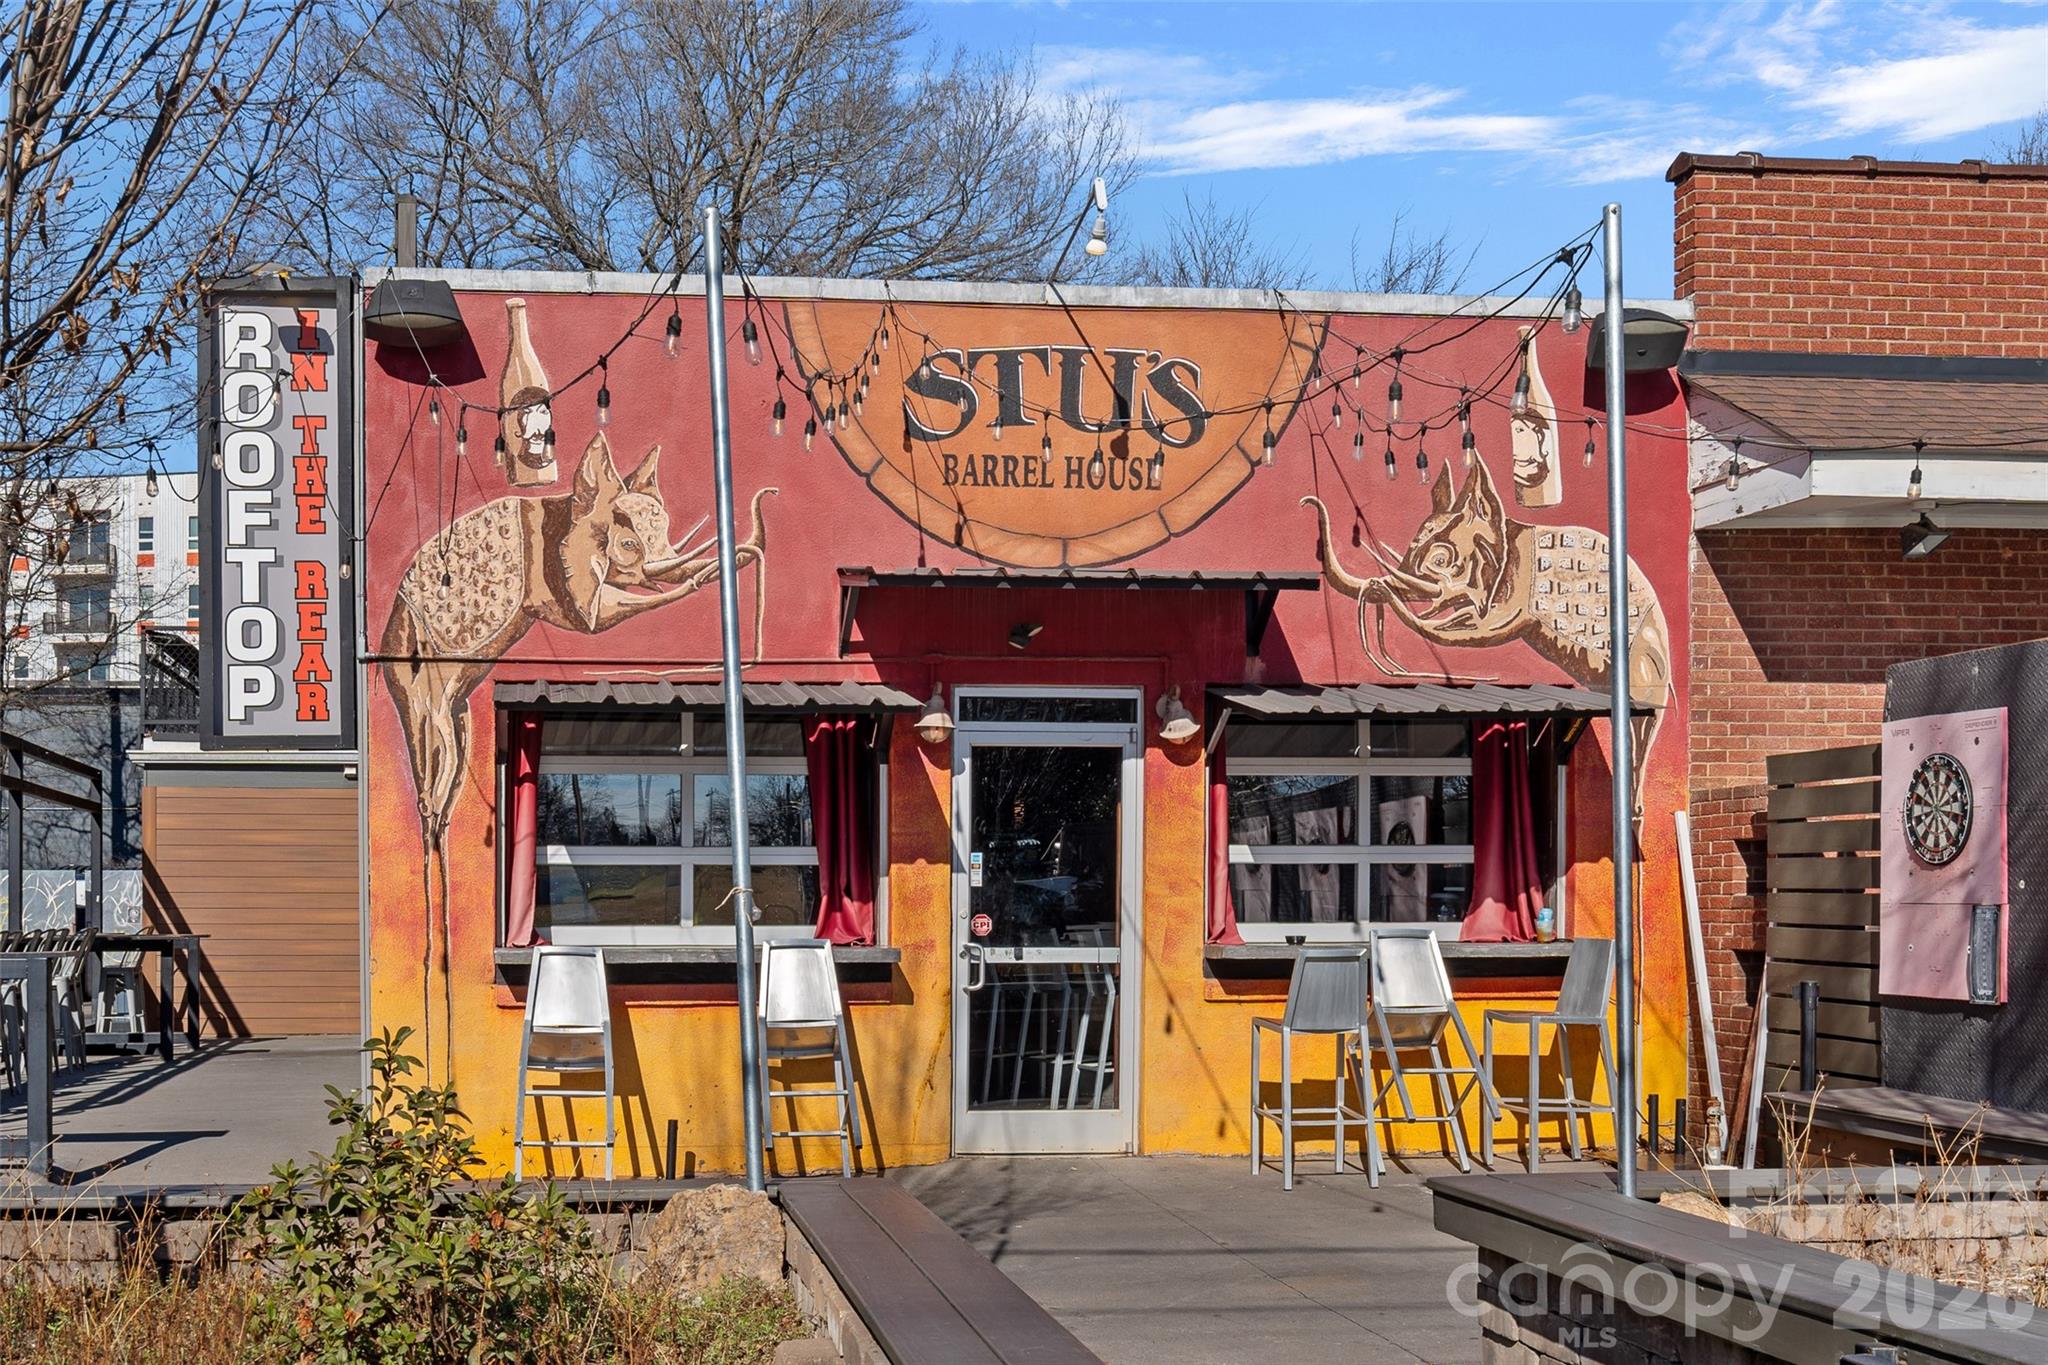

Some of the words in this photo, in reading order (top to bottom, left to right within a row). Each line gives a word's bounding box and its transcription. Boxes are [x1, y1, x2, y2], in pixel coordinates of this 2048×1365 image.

[290, 310, 329, 392] IN
[902, 344, 1207, 449] STU'S
[222, 310, 279, 722] ROOFTOP
[292, 415, 328, 534] THE
[942, 453, 1055, 488] BARREL
[292, 560, 332, 722] REAR
